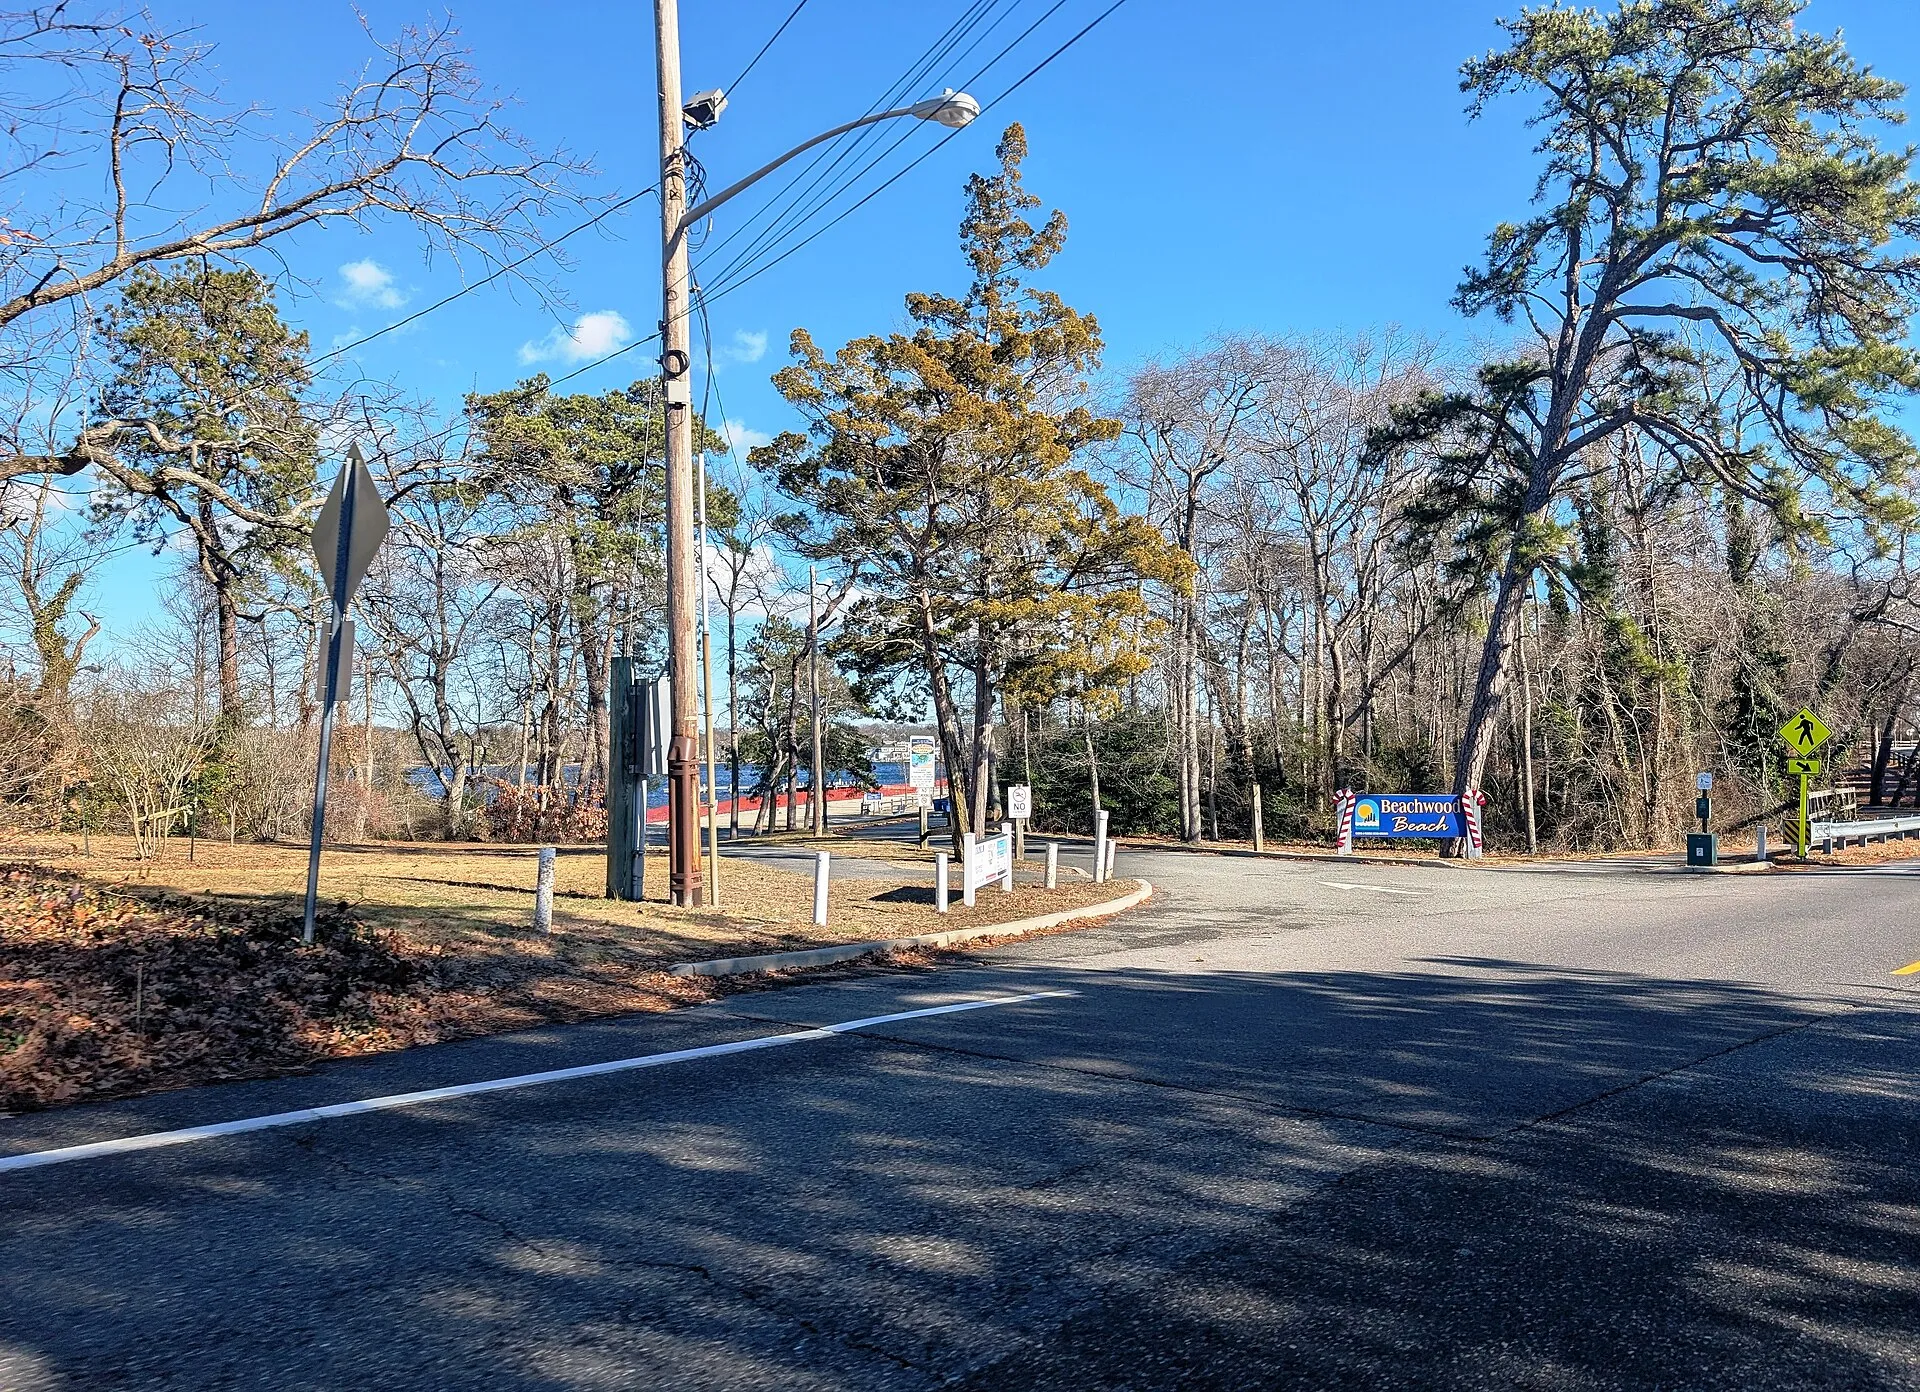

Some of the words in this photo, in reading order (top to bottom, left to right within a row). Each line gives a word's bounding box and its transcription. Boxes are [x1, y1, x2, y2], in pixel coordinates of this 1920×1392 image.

[1013, 802, 1026, 810] NO
[1381, 799, 1461, 814] Beachwood
[1392, 815, 1449, 832] Beach
